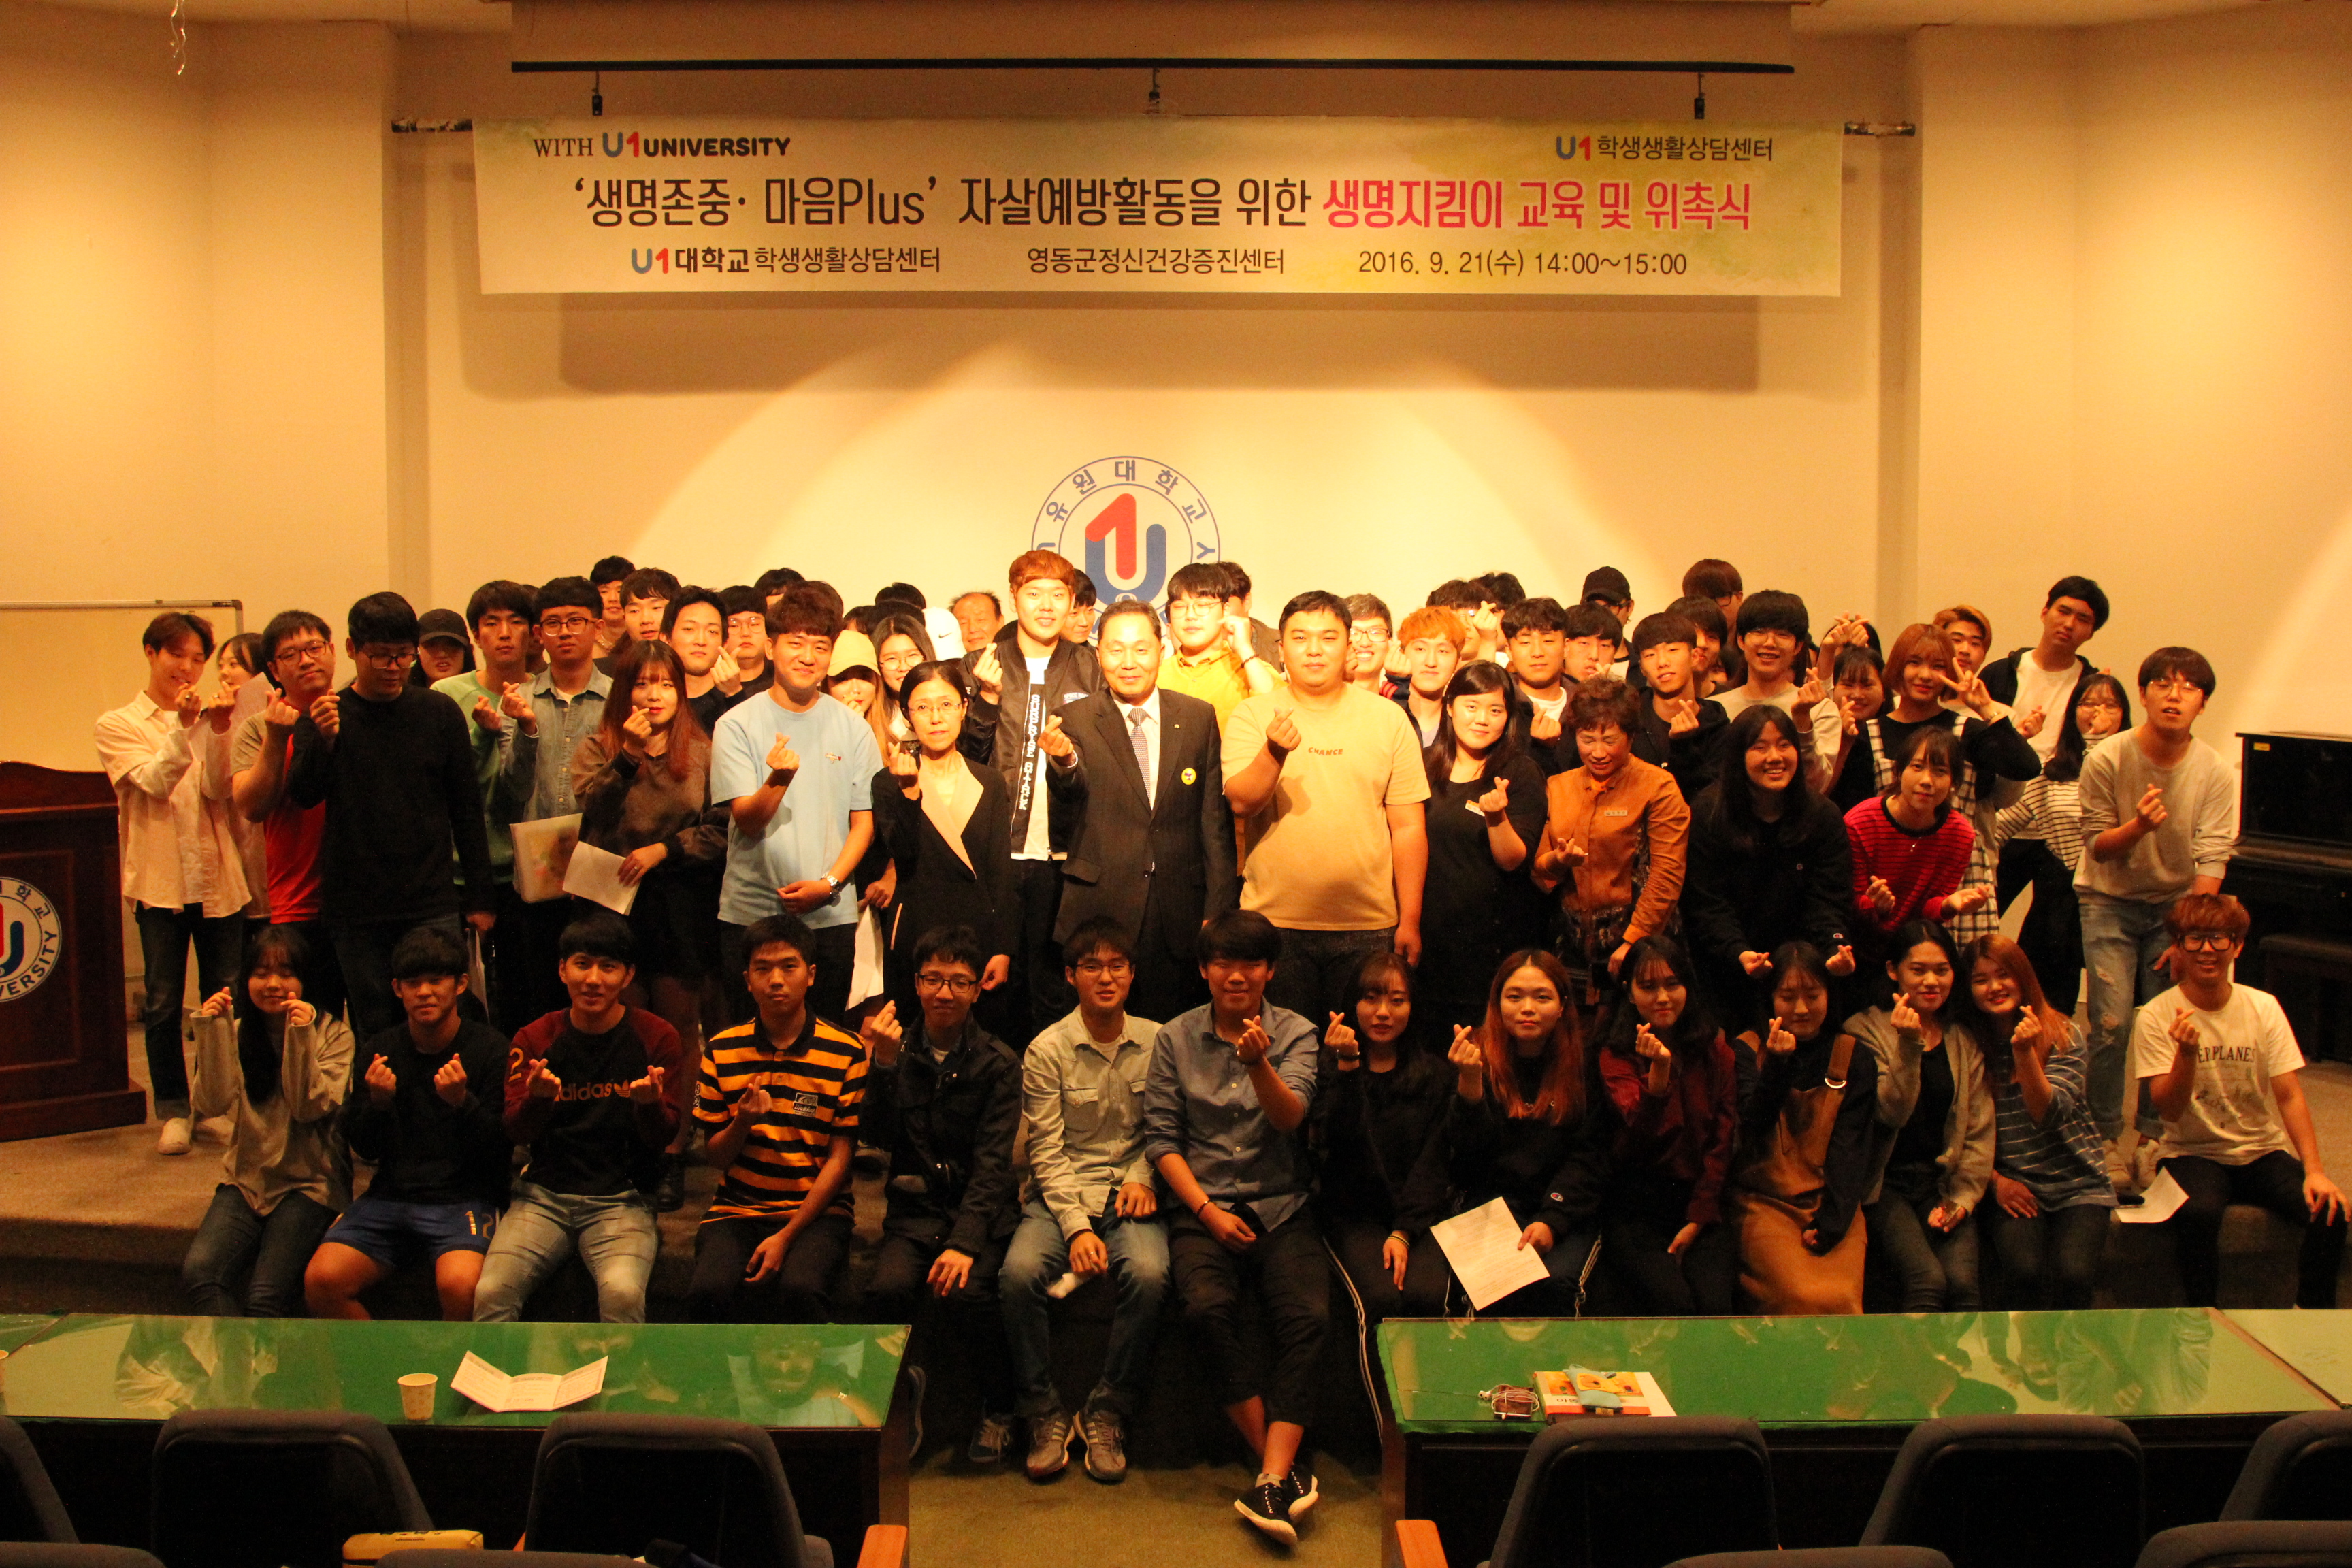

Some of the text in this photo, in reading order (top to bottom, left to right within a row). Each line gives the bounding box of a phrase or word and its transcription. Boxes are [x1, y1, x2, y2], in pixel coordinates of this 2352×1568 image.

[532, 137, 594, 158] WITH
[643, 137, 791, 158] UNIVERSITY
[1555, 135, 1774, 161] U1 학생생활상담센터
[958, 176, 1223, 227] 자살예방활동을
[1236, 178, 1312, 227] 위한
[1322, 179, 1503, 229] 생명지킴이
[1517, 180, 1585, 229] 교육
[1599, 182, 1631, 229] 및
[1644, 181, 1751, 231] 위촉식
[1027, 247, 1285, 275] 영동군정신건강증진센터
[1459, 248, 1524, 277] 21(수)
[1308, 747, 1343, 756] CHANCE
[0, 880, 52, 919] 학교
[2196, 1045, 2255, 1063] ERPLANES
[554, 1082, 612, 1102] didas
